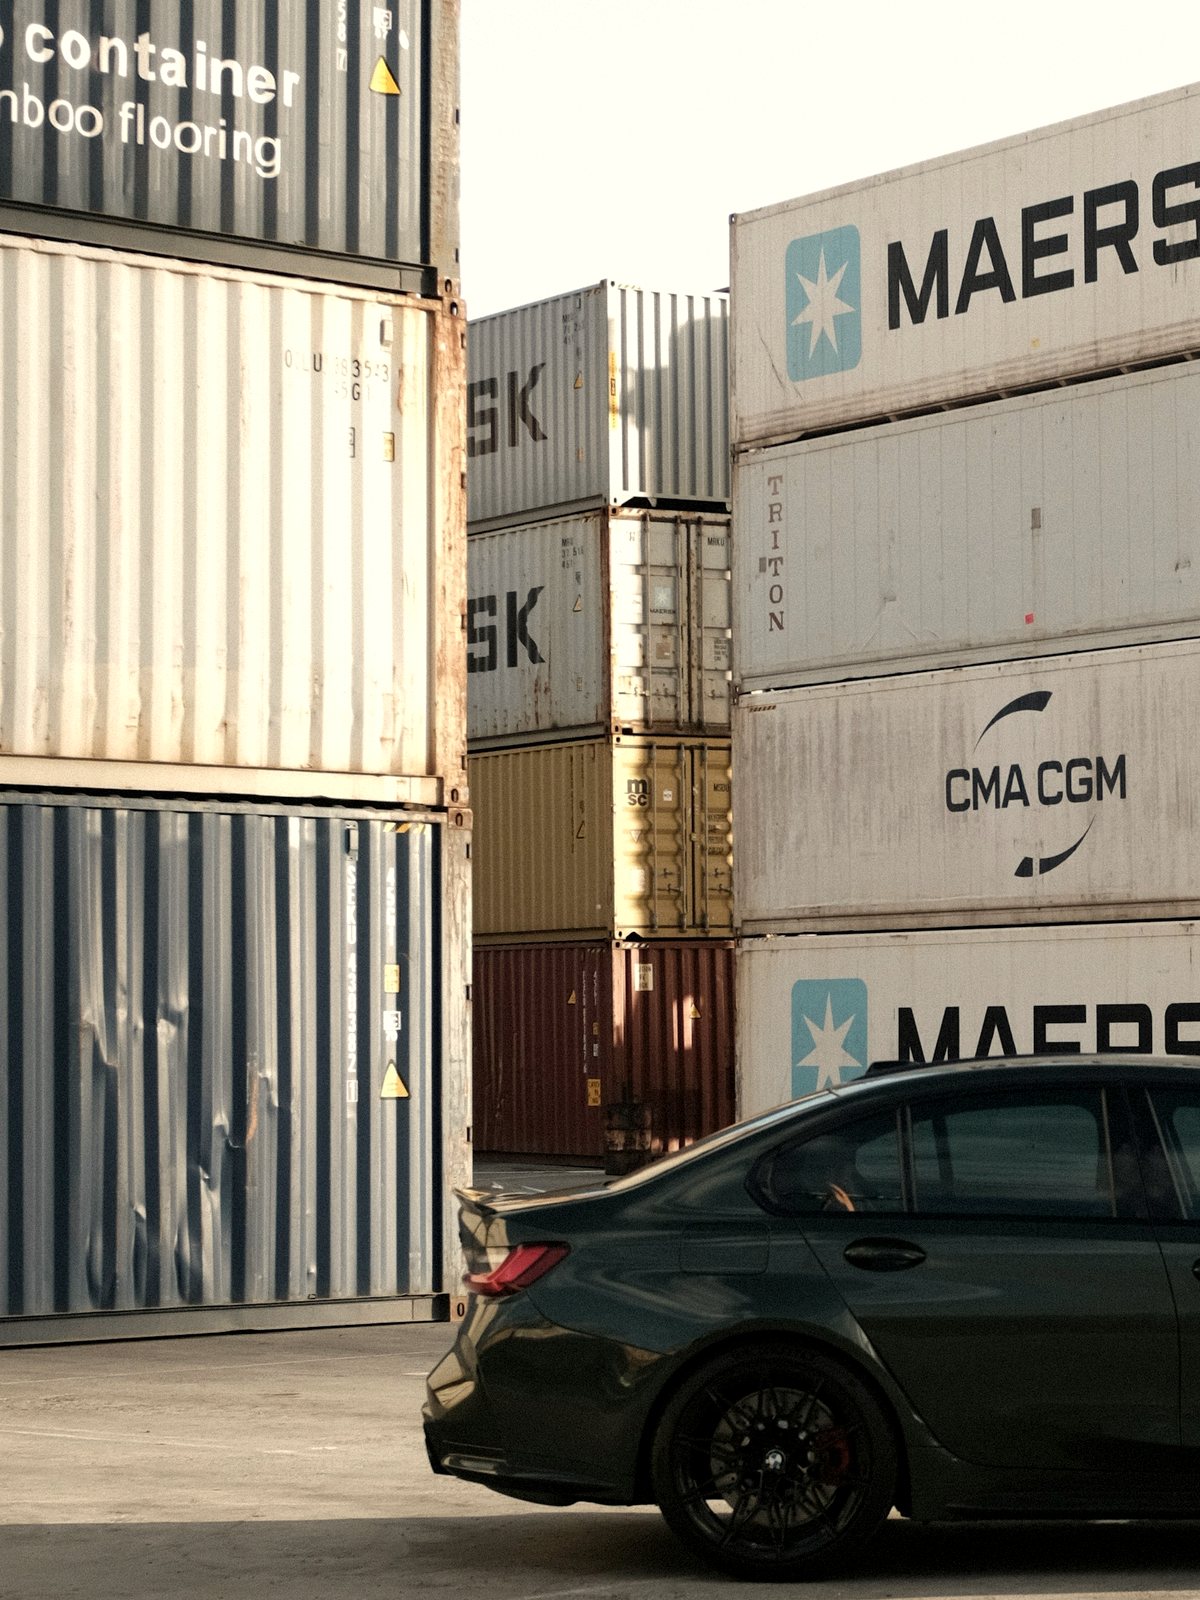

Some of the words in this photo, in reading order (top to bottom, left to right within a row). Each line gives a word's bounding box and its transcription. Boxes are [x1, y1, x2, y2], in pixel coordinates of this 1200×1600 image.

[25, 23, 300, 108] container
[119, 101, 281, 178] flooring
[767, 475, 785, 632] TRITON
[946, 763, 1030, 813] CMA
[1037, 754, 1126, 806] CGM
